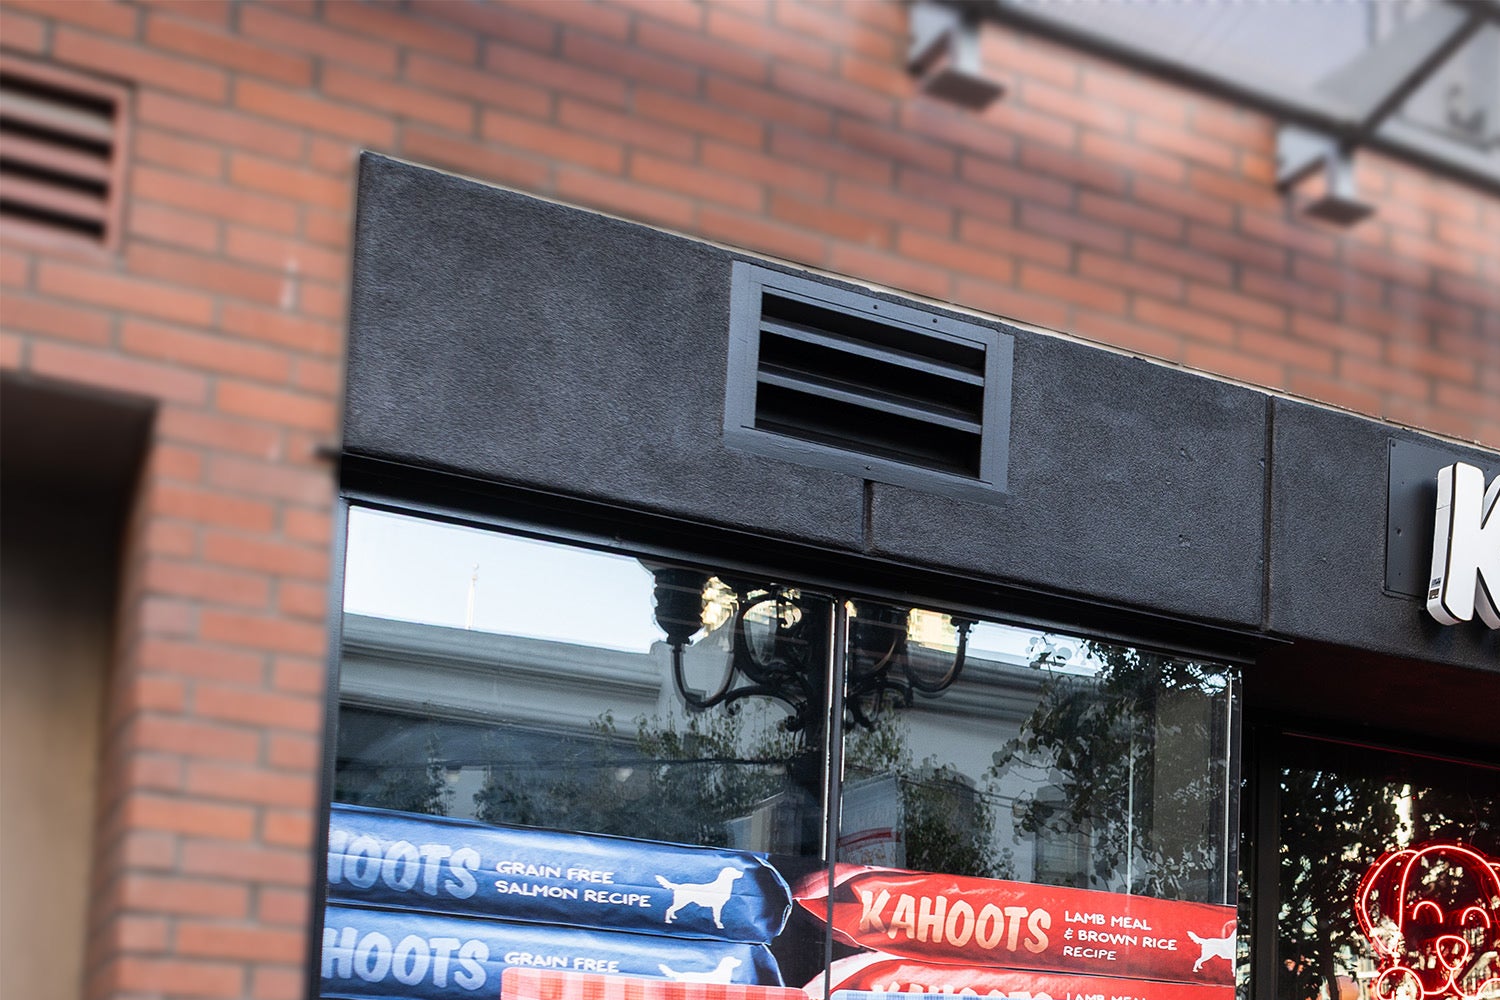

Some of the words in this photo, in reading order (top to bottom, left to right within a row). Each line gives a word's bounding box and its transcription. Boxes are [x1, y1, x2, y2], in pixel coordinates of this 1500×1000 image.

[496, 861, 561, 878] GRAIN
[566, 868, 615, 884] FREE
[494, 881, 578, 899] SALMON
[583, 890, 652, 907] RECIPE
[859, 889, 1052, 954] KAHOOTS
[1065, 911, 1106, 925] LAMB
[1111, 916, 1152, 931] MEAL
[1078, 930, 1138, 946] BROWN
[1142, 938, 1177, 951] RICE
[321, 926, 490, 991] HOOTS
[504, 952, 568, 968] GRAIN
[573, 957, 620, 972] FREE
[1063, 946, 1117, 961] RECIPE
